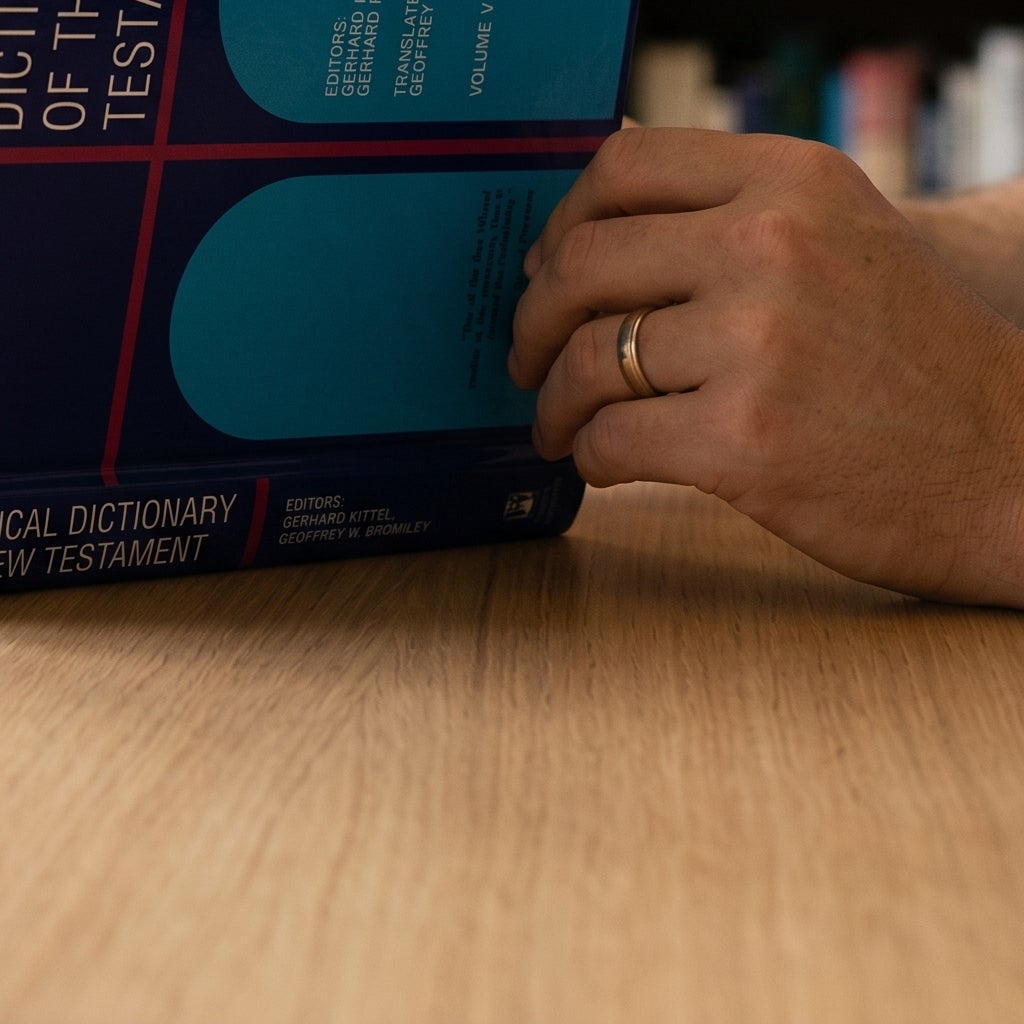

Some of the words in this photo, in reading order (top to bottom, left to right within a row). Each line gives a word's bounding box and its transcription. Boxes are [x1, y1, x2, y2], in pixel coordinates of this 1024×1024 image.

[325, 17, 347, 97] EDITORS:
[341, 11, 364, 97] GERHARD
[357, 11, 380, 97] GERHARD
[409, 4, 434, 97] GEOFFREY
[469, 21, 492, 97] VOLUME
[481, 2, 494, 15] V
[42, 71, 89, 131] OF
[68, 493, 238, 536] DICTIONARY
[278, 527, 346, 545] GEOFFREY
[347, 526, 361, 539] W.
[364, 520, 432, 538] BROMILEY
[282, 511, 346, 529] GERHARD
[44, 533, 210, 575] TESTAMENT
